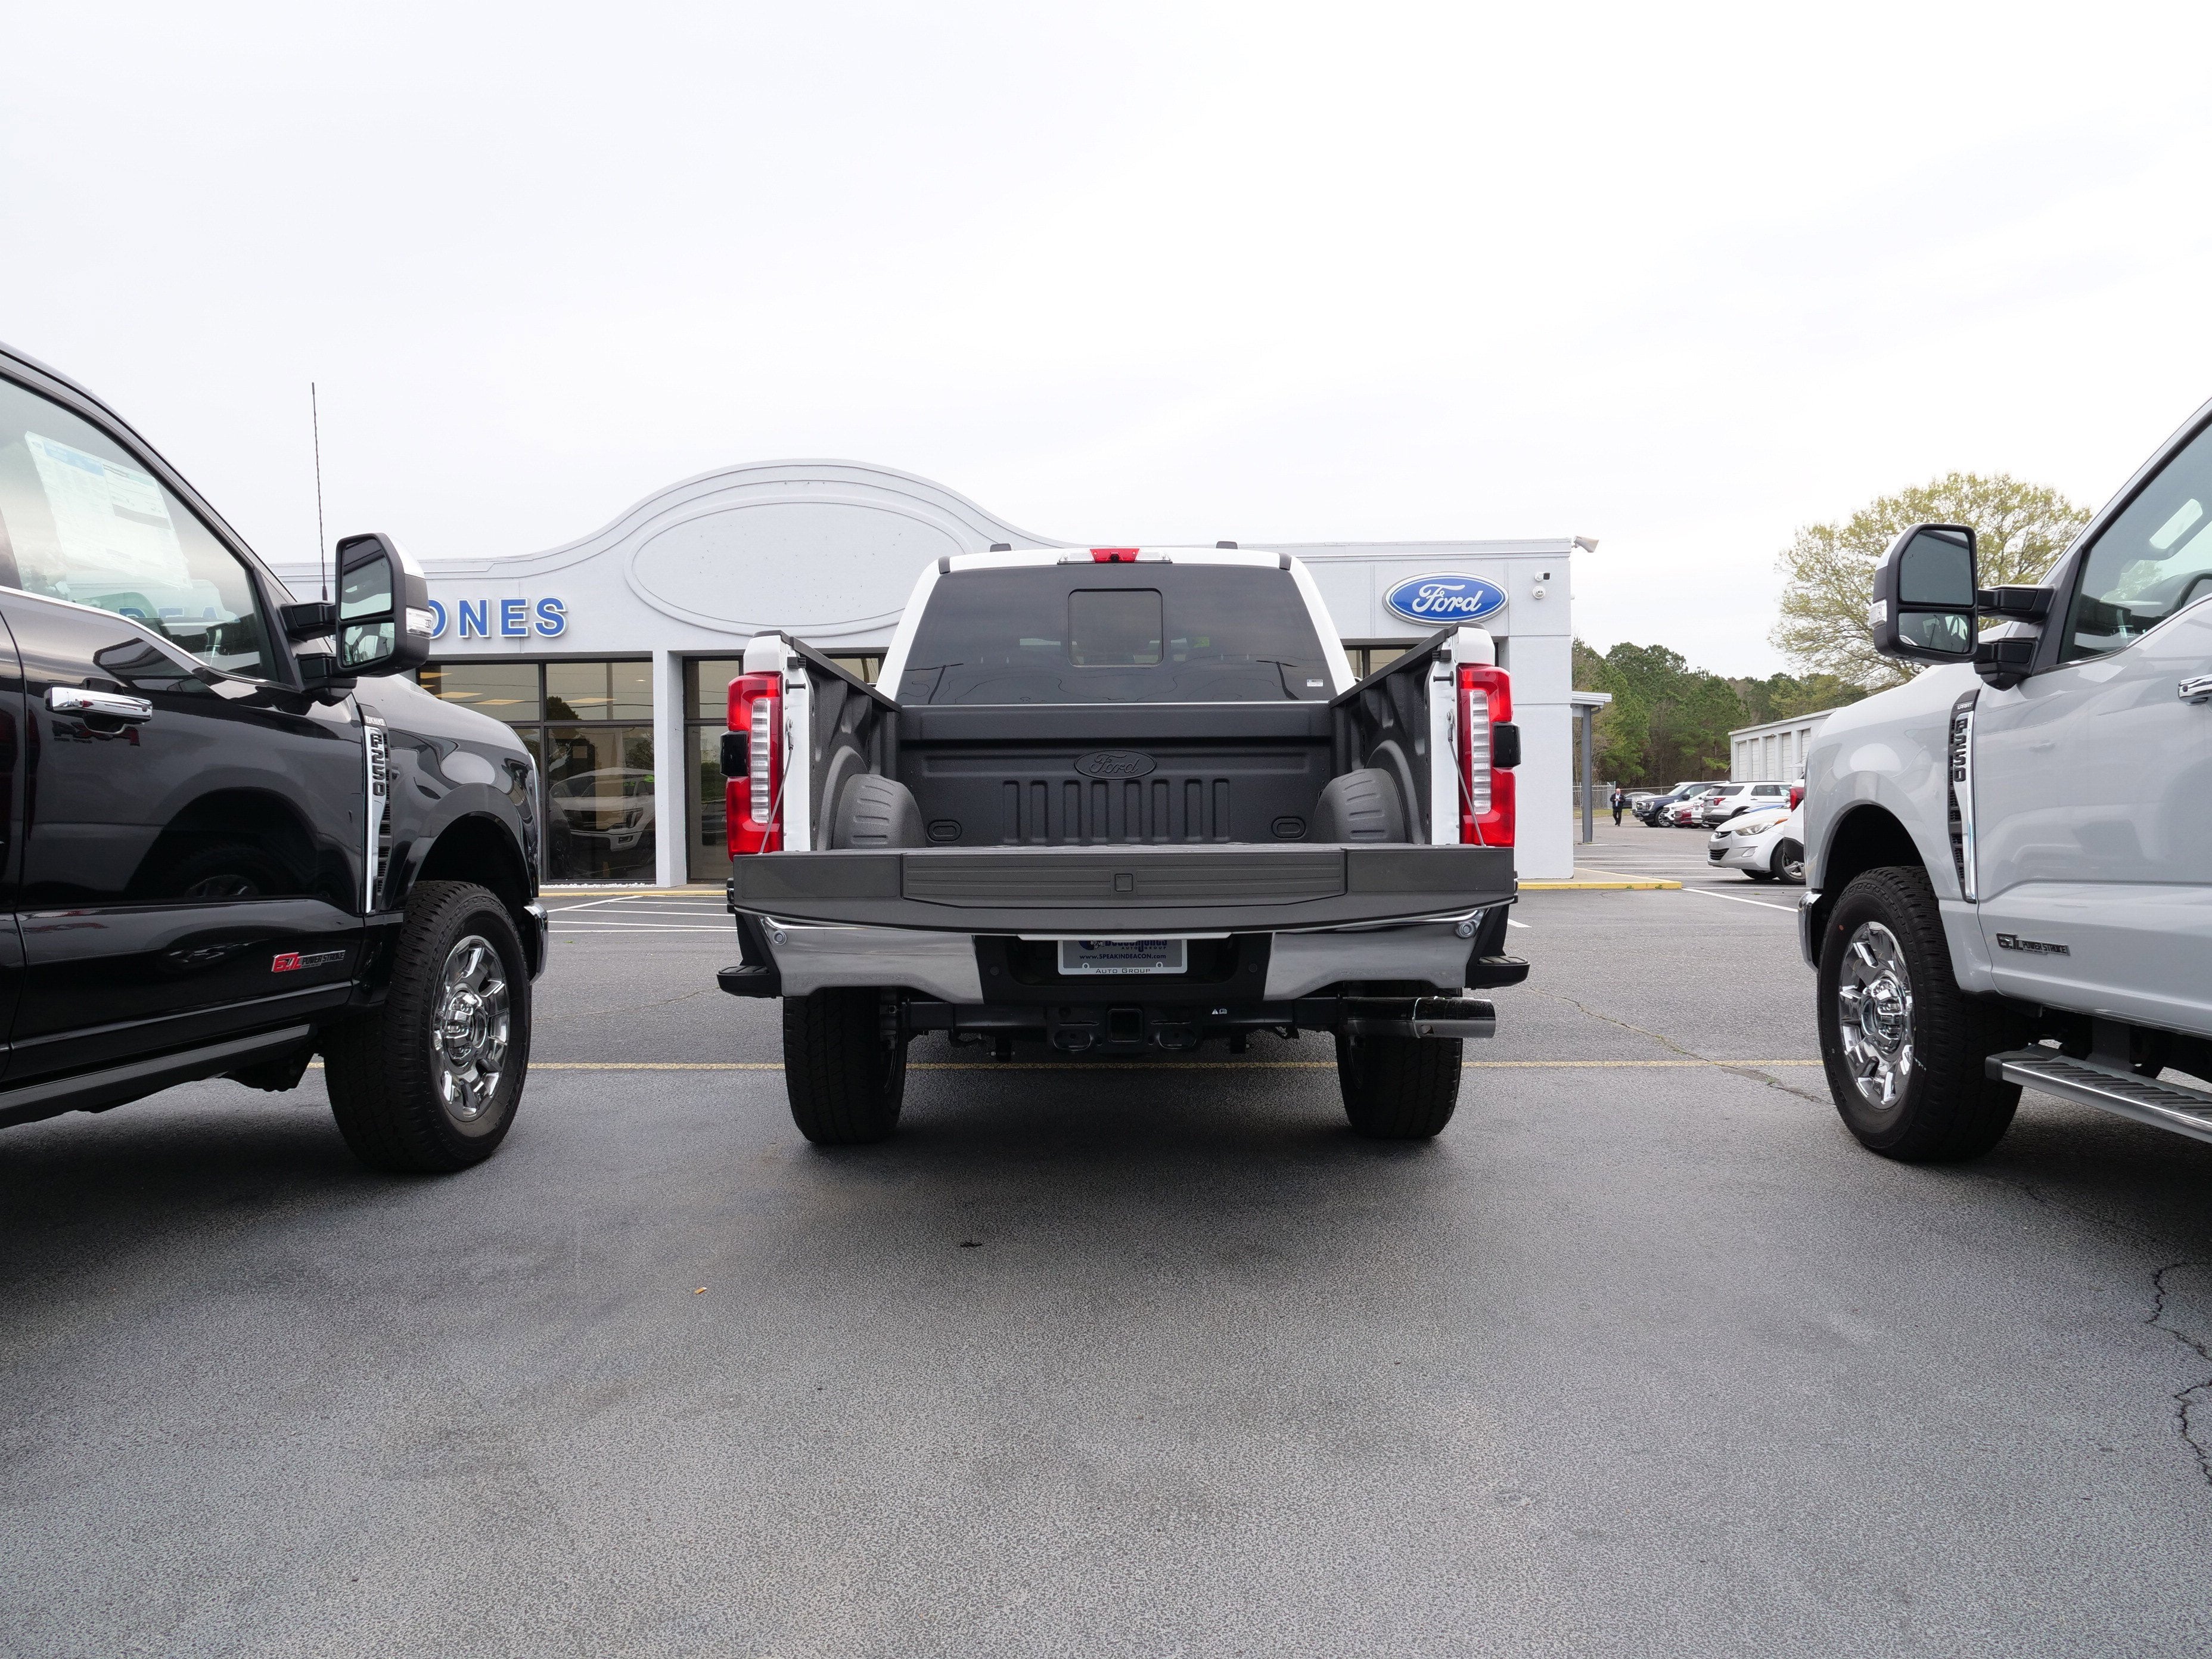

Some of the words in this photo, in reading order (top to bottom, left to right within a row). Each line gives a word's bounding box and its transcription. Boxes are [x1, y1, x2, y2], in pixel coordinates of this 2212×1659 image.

[1412, 583, 1484, 613] Ford
[1089, 754, 1140, 773] Ford
[302, 955, 322, 965] POWER
[322, 953, 345, 962] STROKE
